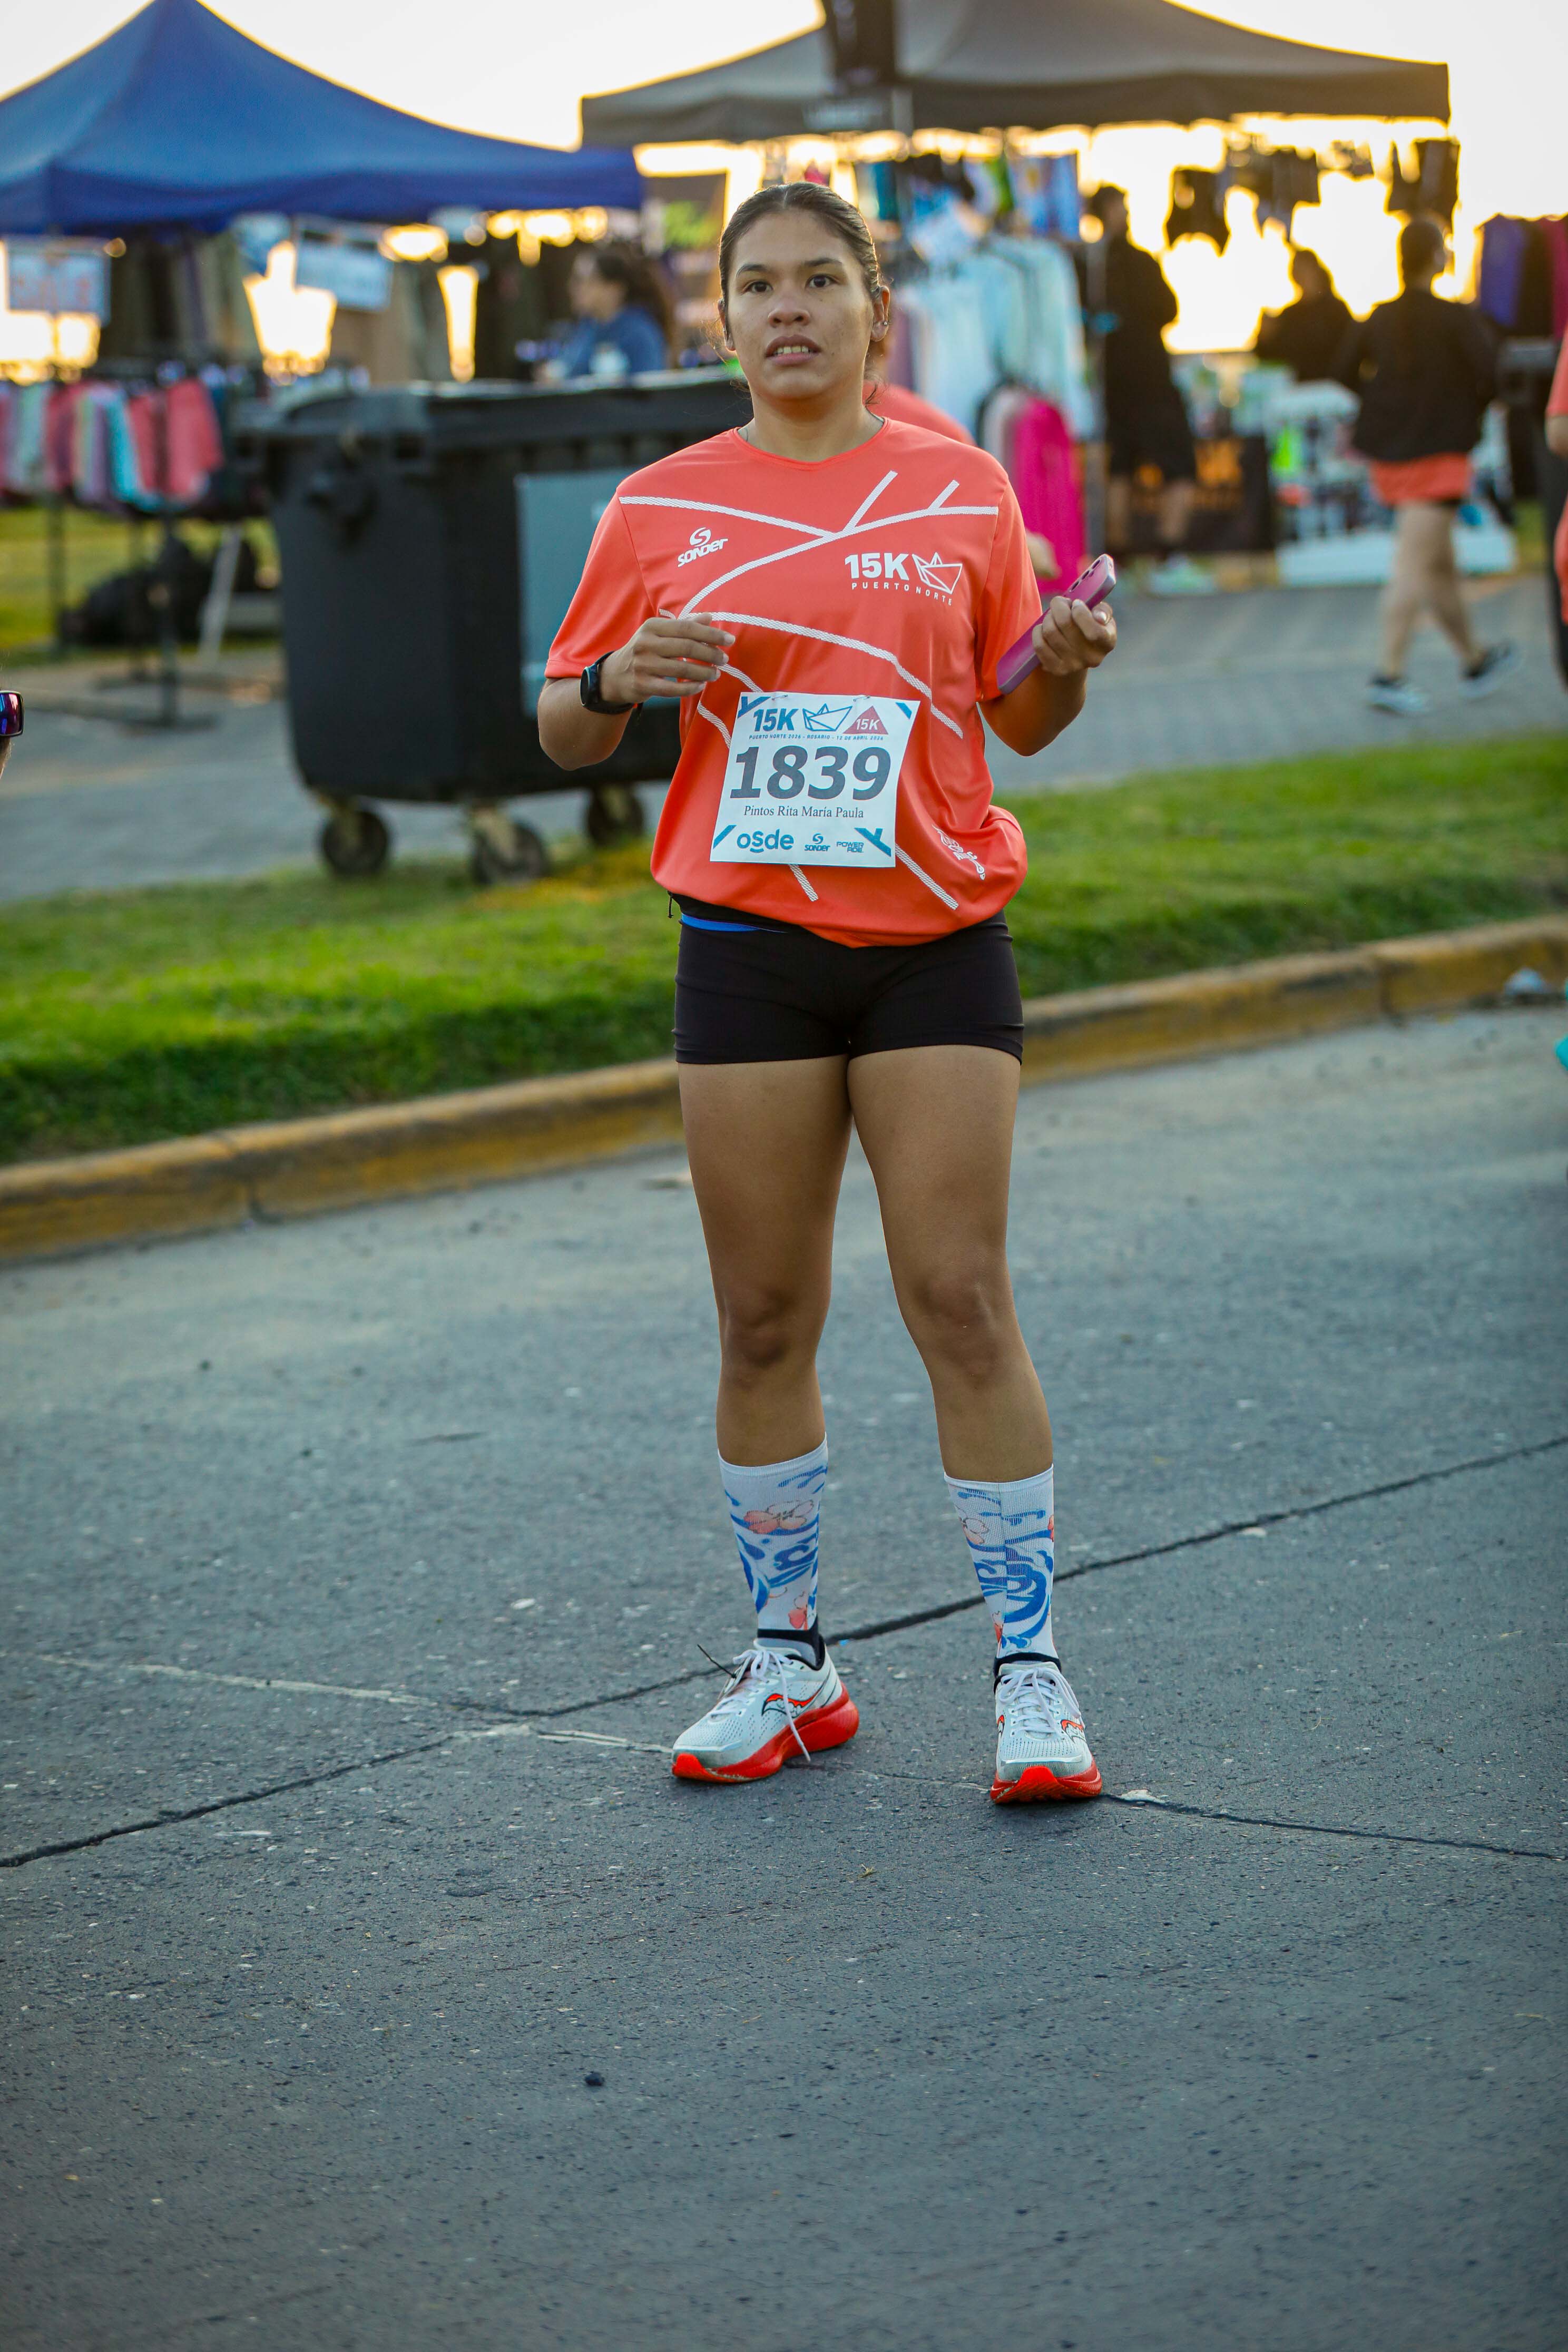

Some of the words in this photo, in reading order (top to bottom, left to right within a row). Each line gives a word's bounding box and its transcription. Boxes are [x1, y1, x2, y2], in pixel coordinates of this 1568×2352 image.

[845, 553, 909, 581] 15K
[851, 582, 909, 591] PUERTO
[916, 586, 952, 606] NORTE
[753, 708, 799, 731] 15K
[856, 719, 880, 730] 15K
[730, 745, 891, 800] 1839
[744, 806, 775, 816] Pintos
[777, 806, 798, 816] Rita
[802, 806, 832, 817] María
[836, 807, 864, 818] Paula
